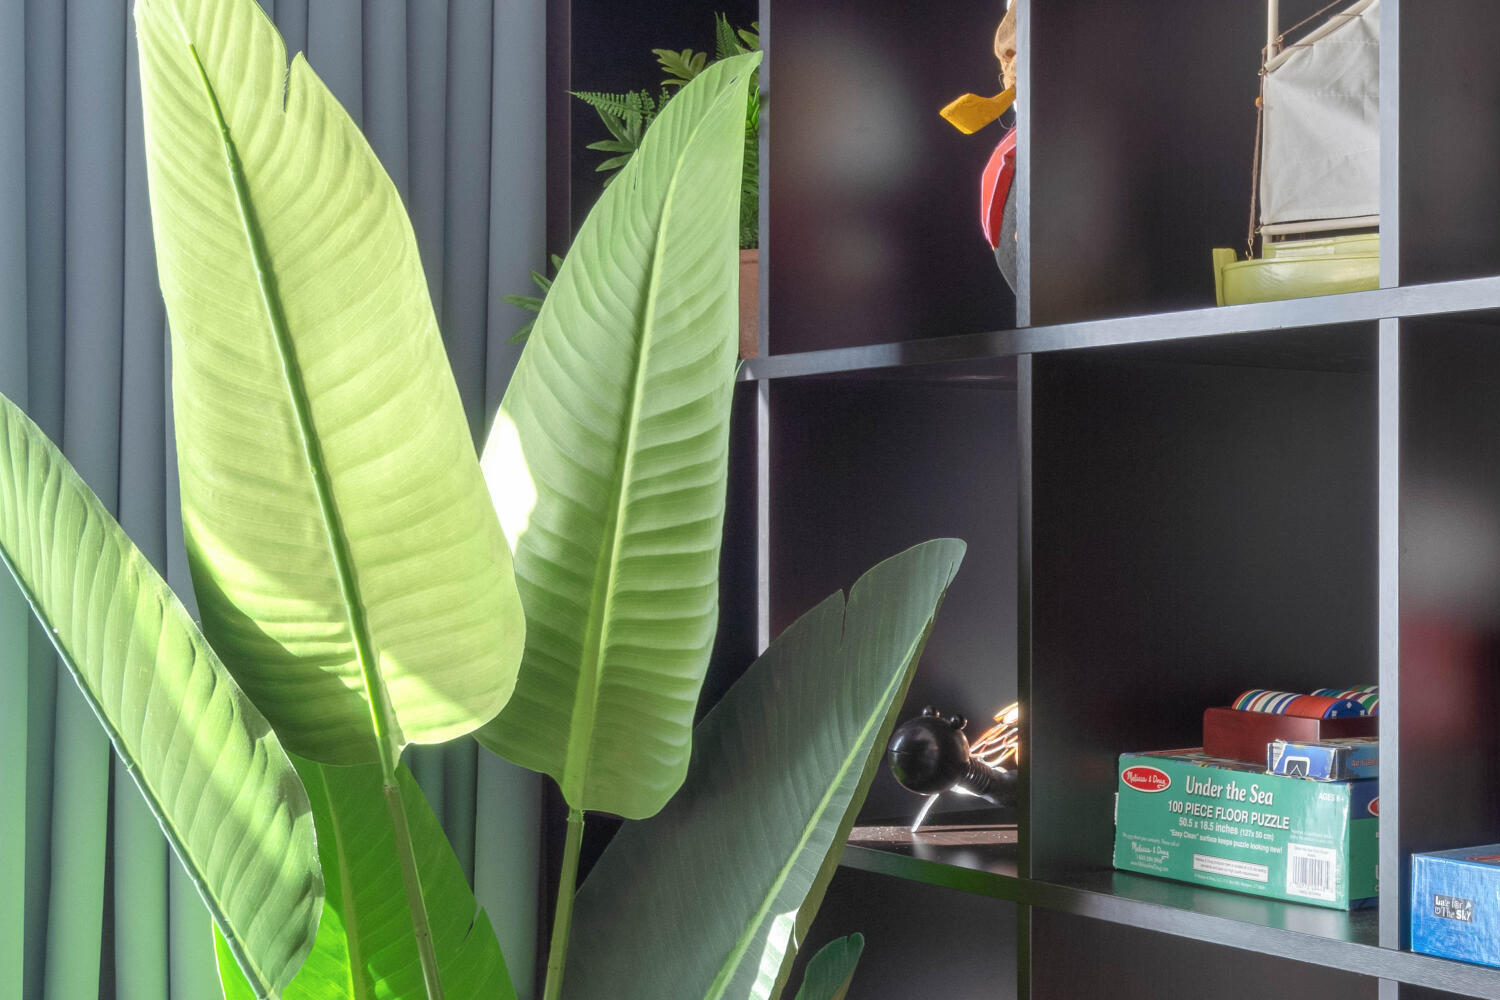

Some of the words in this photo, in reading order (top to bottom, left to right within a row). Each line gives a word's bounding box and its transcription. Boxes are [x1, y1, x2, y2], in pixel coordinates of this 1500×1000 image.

[1185, 776, 1223, 798] Under
[1225, 781, 1246, 801] the
[1249, 784, 1273, 805] Sea
[1319, 792, 1335, 801] AGES
[1168, 800, 1183, 814] 100
[1185, 802, 1213, 818] PIECE
[1215, 806, 1248, 824] FLOOR
[1251, 811, 1290, 830] PUZZLE
[1178, 816, 1193, 828] 50.5
[1200, 820, 1214, 832] 18.5
[1215, 822, 1239, 835] inches
